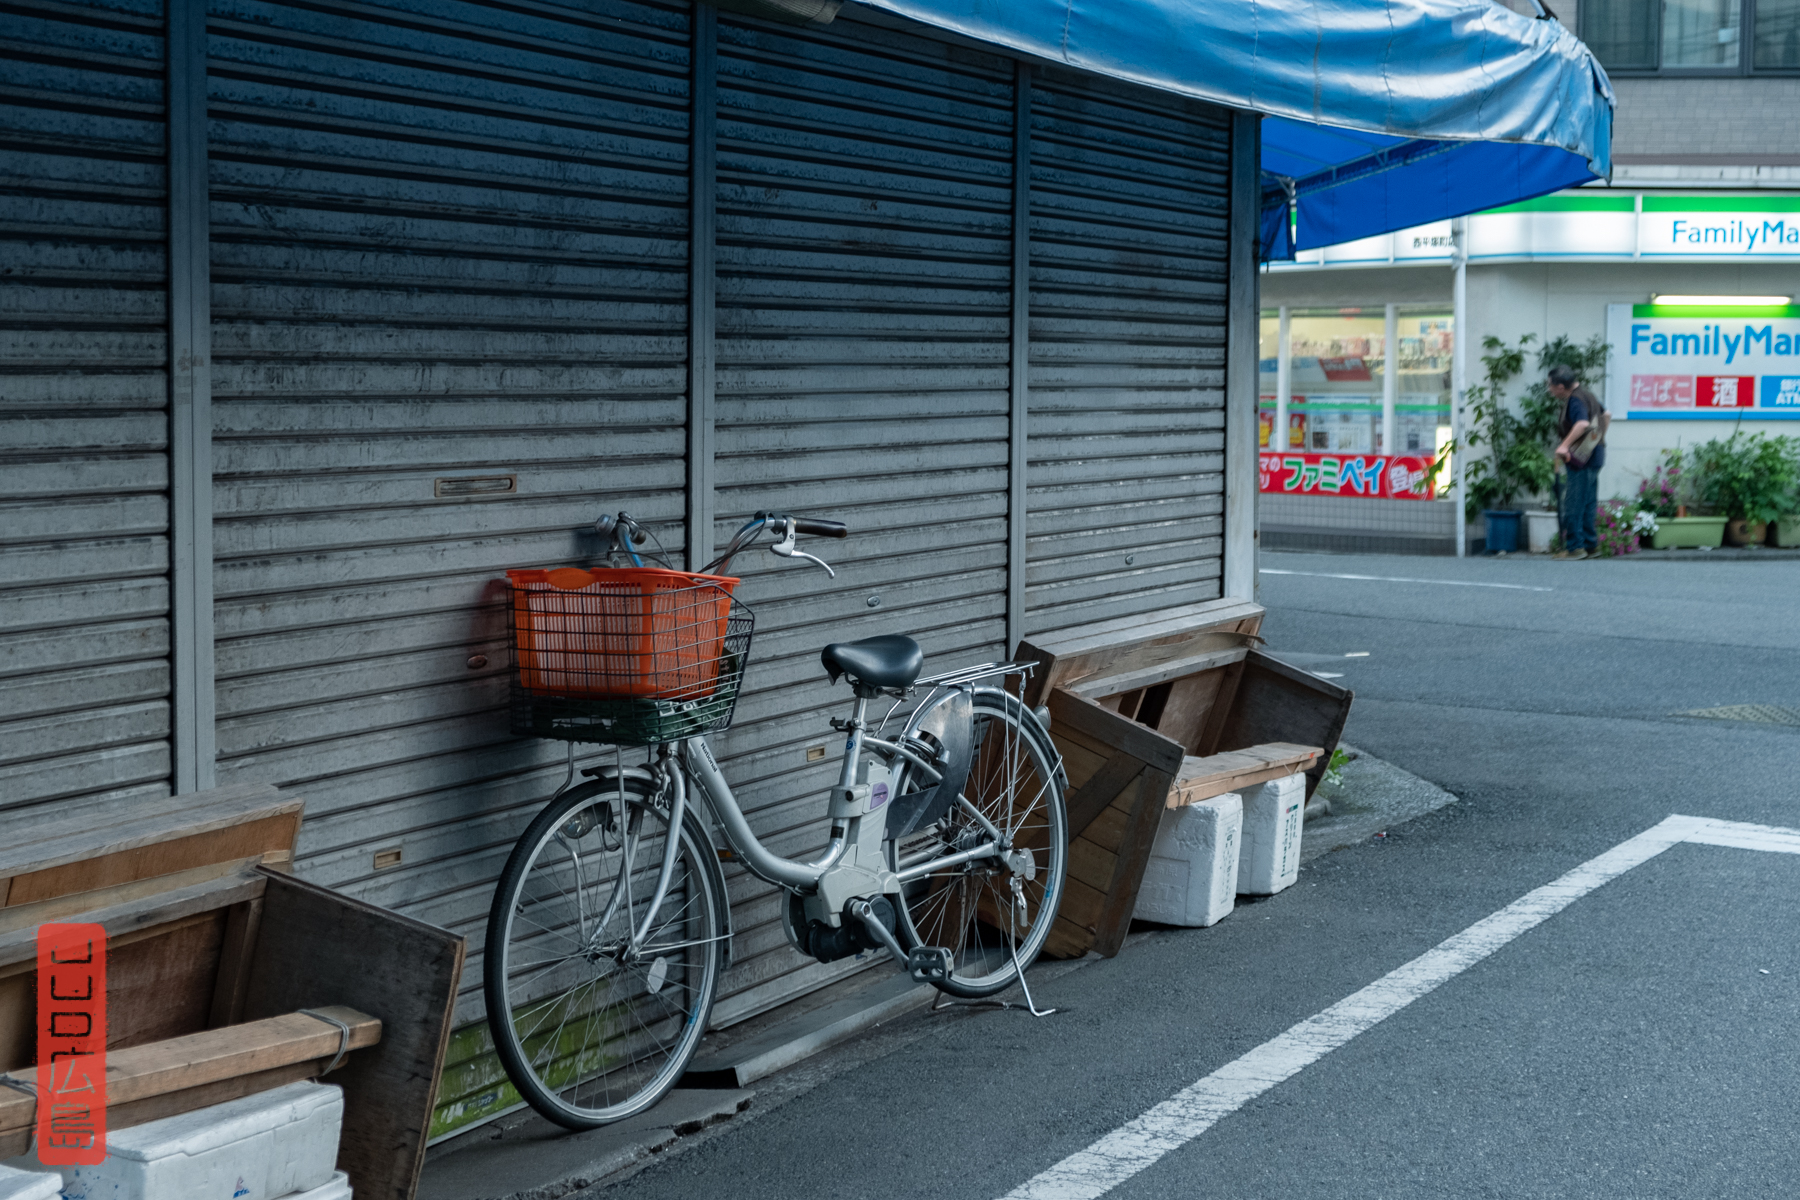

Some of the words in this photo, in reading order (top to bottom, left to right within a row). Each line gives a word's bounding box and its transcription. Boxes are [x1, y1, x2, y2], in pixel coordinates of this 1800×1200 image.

[1672, 219, 1799, 251] FamilyMa
[1633, 378, 1692, 402] たばこ
[1711, 376, 1739, 406] 酒
[1283, 456, 1387, 494] ファミペイ
[700, 742, 718, 773] National
